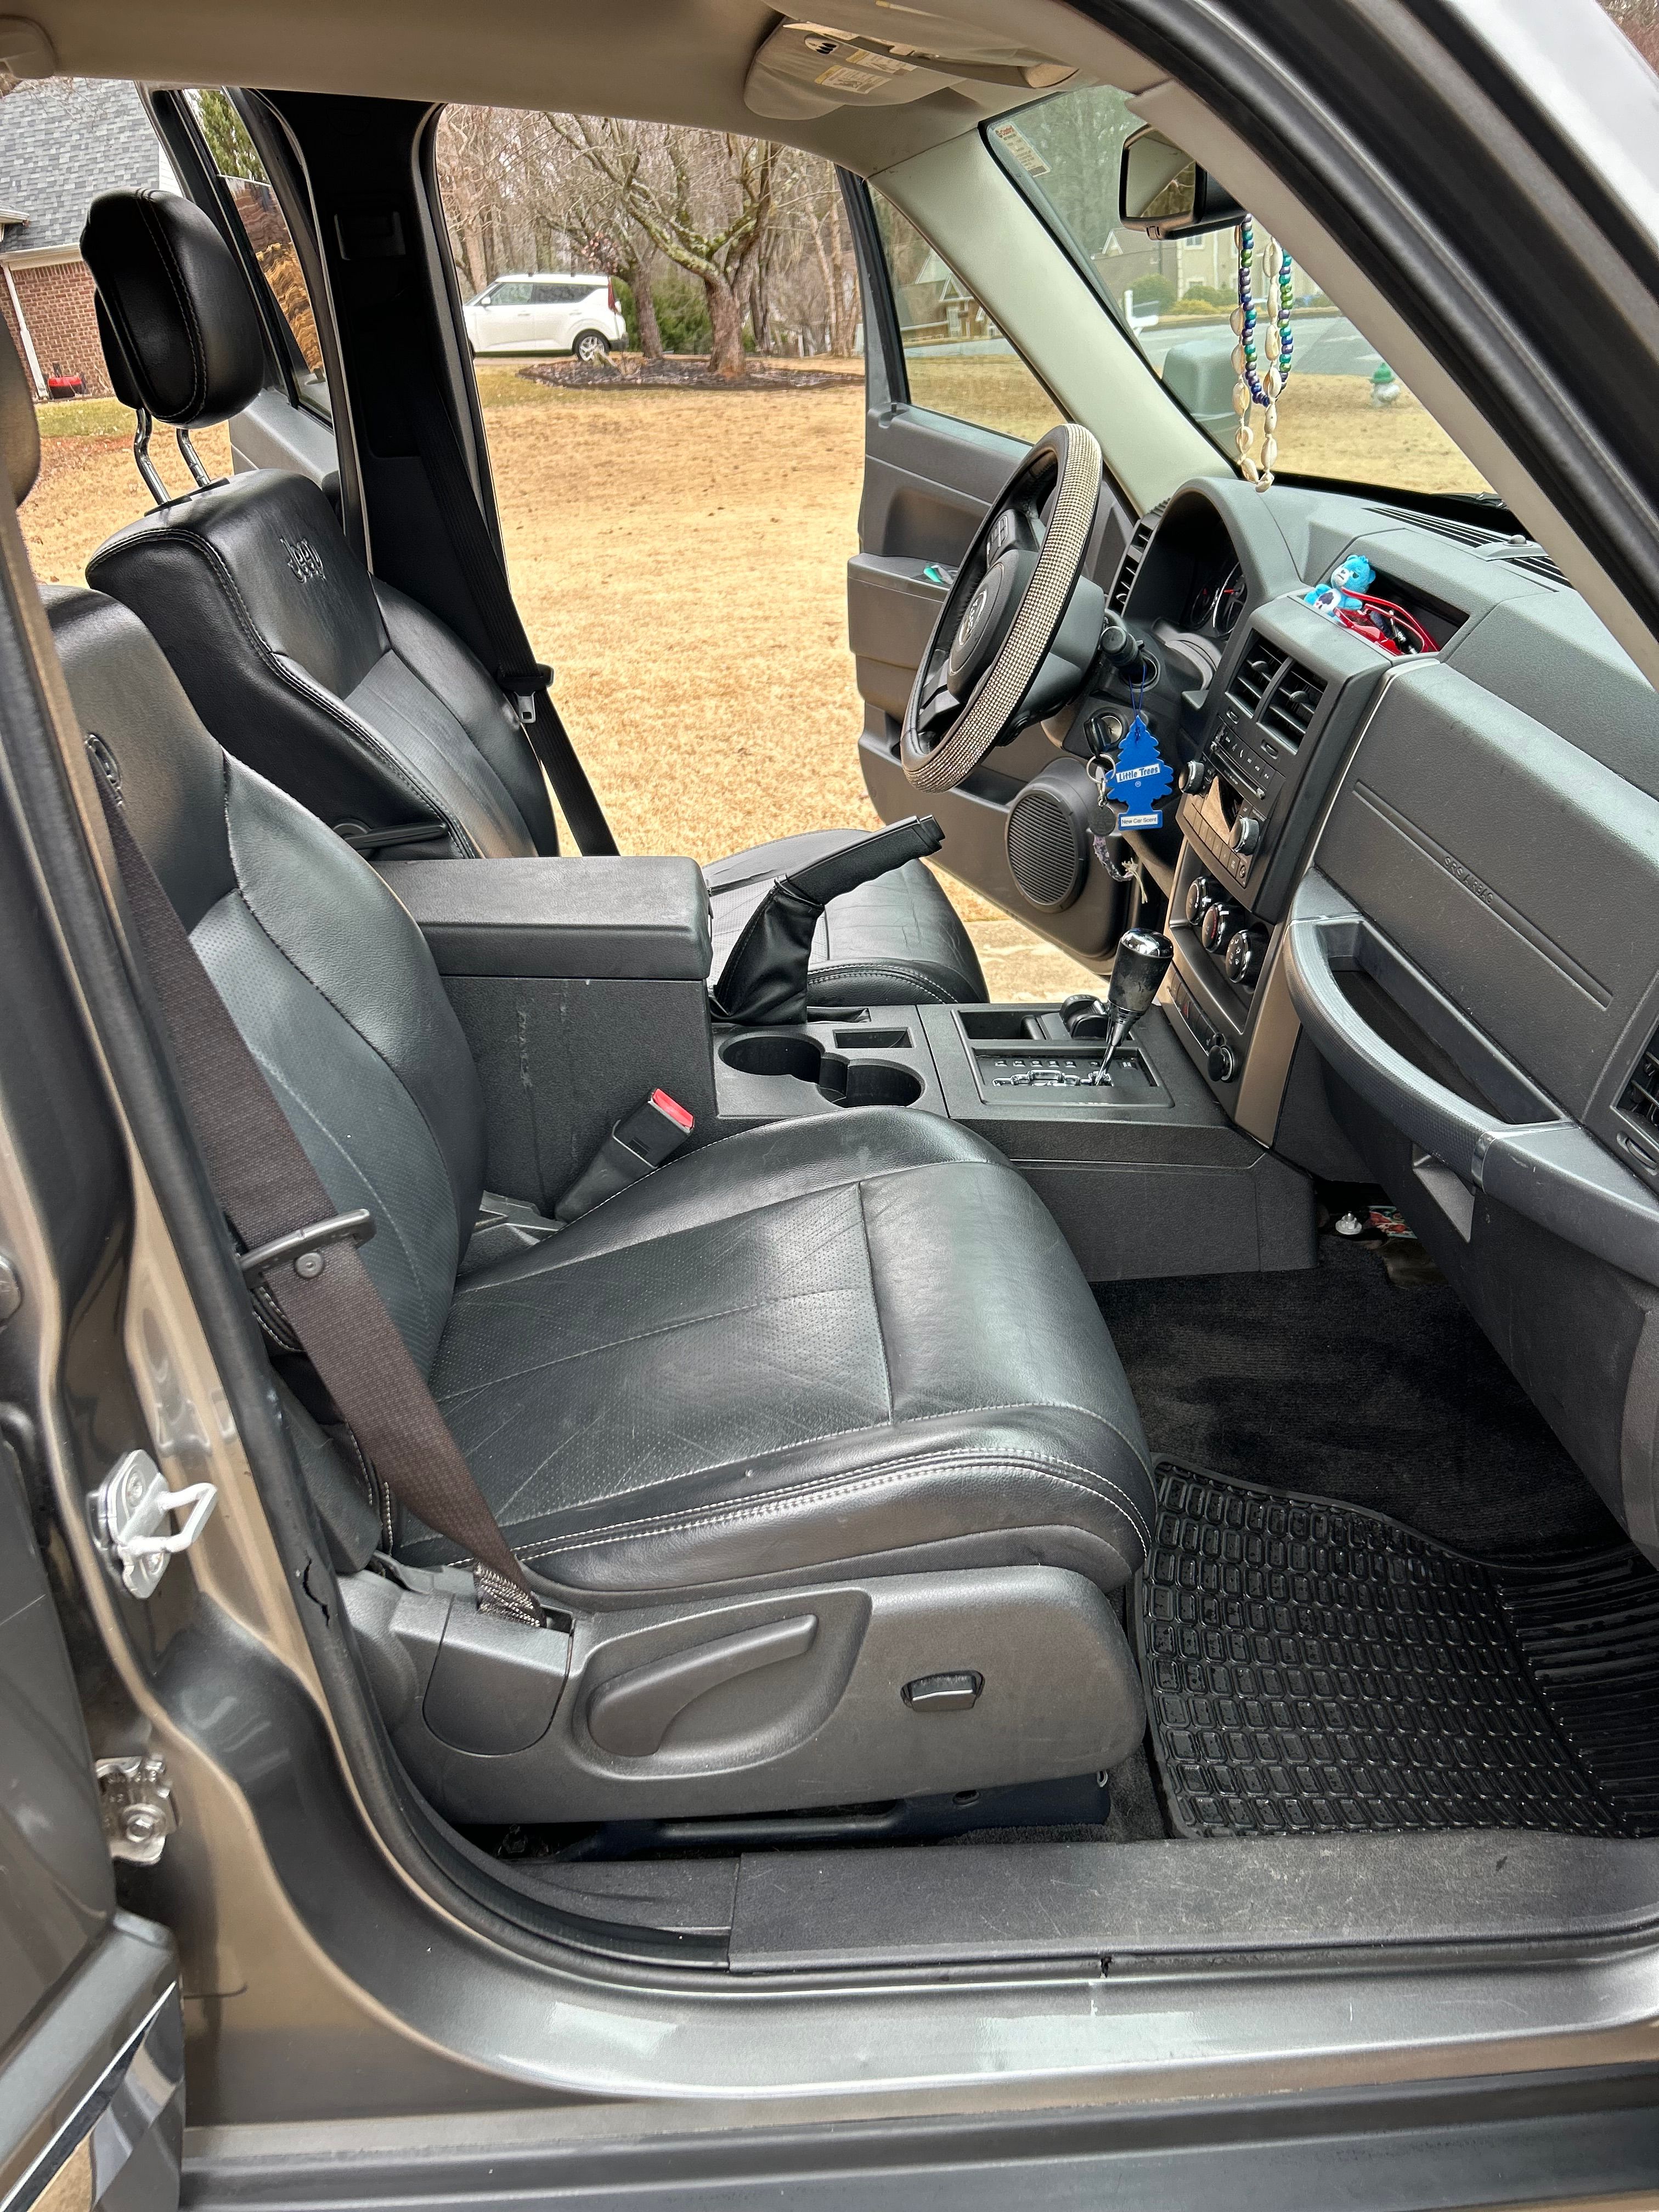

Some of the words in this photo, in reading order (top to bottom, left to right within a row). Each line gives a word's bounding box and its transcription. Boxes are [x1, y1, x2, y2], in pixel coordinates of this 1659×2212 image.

[280, 536, 326, 584] Jeep
[1119, 771, 1137, 781] Little
[1139, 767, 1158, 776] Trees
